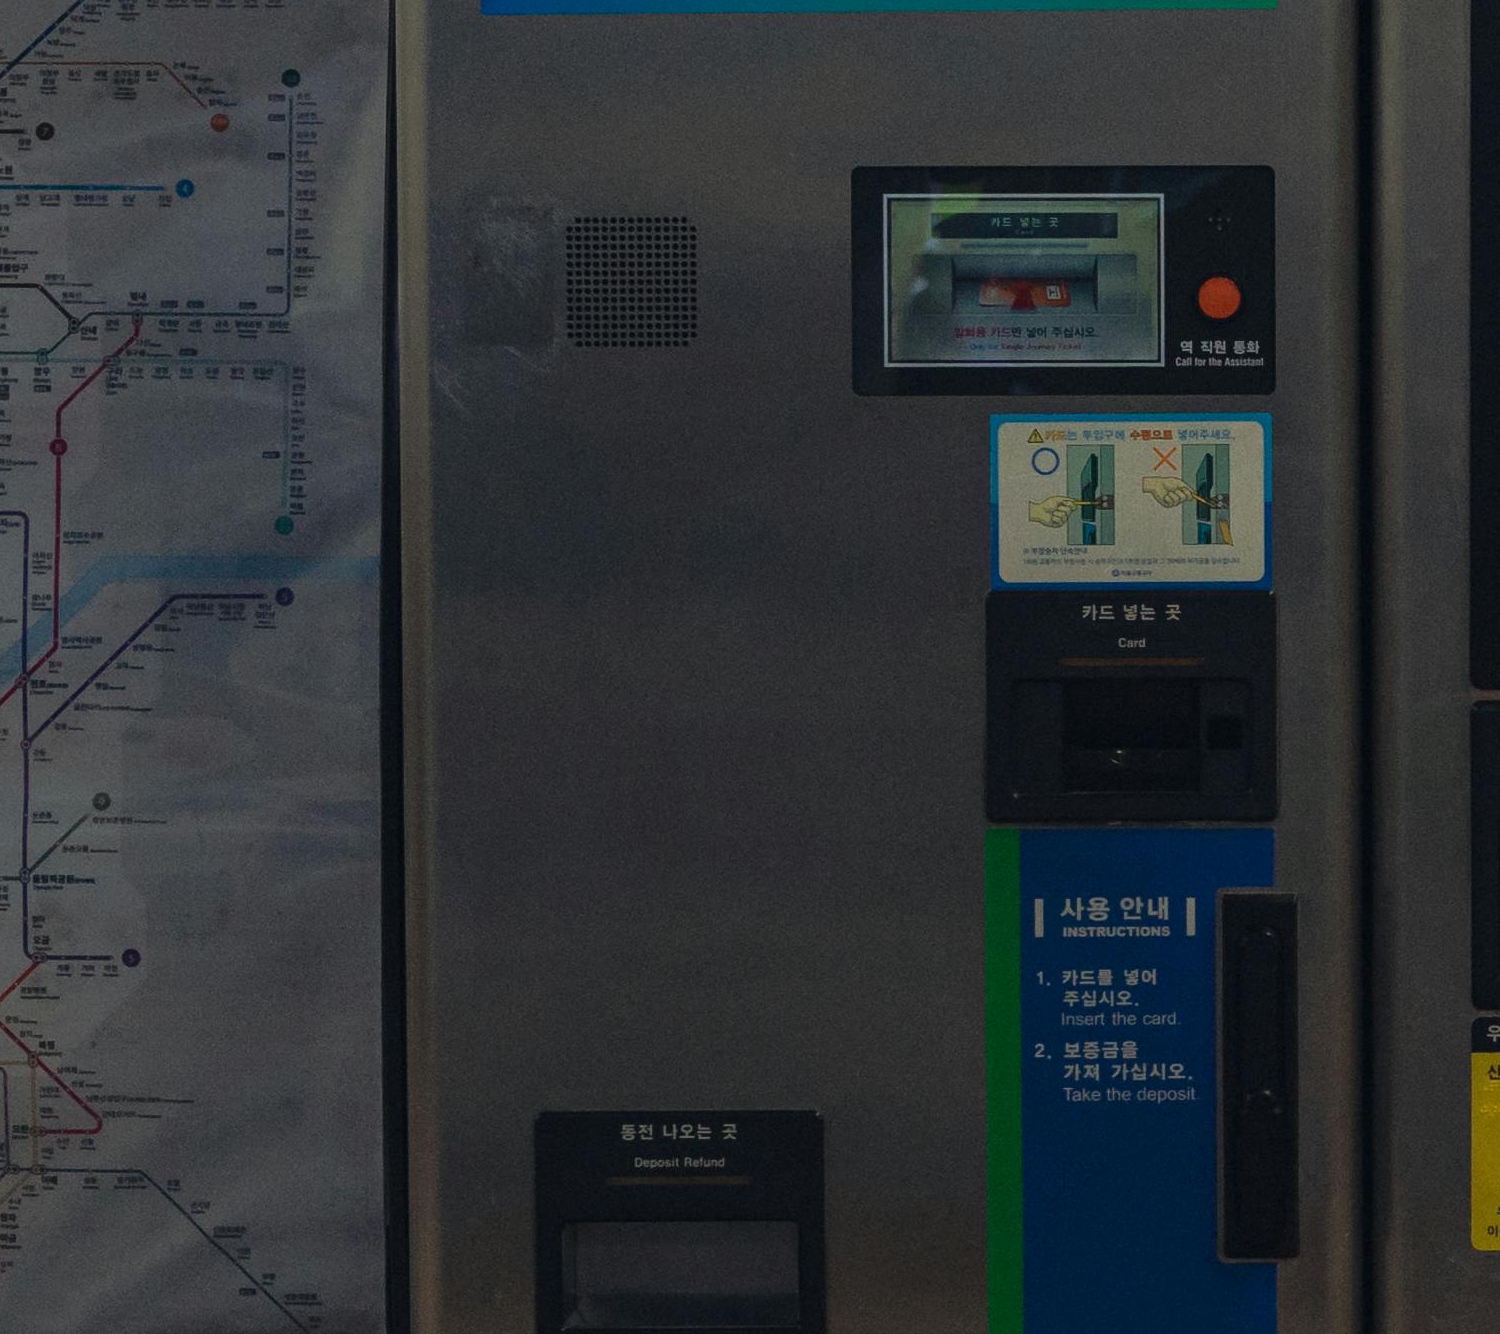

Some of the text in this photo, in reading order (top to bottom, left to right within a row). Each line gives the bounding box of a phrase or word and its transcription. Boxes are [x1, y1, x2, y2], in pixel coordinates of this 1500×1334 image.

[1179, 339, 1260, 355] 역 직원 통화
[1174, 356, 1265, 367] Call for the Assistant
[1082, 603, 1182, 622] 카드 넣는 곳
[1117, 637, 1147, 649] Card
[1060, 896, 1169, 922] 사용 안내
[1062, 925, 1171, 938] INSTRUCTIONS
[1036, 968, 1157, 987] 1. 카드를 넣어
[1061, 989, 1141, 1008] 주십시오.
[620, 1123, 738, 1142] 동전 나오는 곳
[633, 1156, 726, 1170] Deposit Refund
